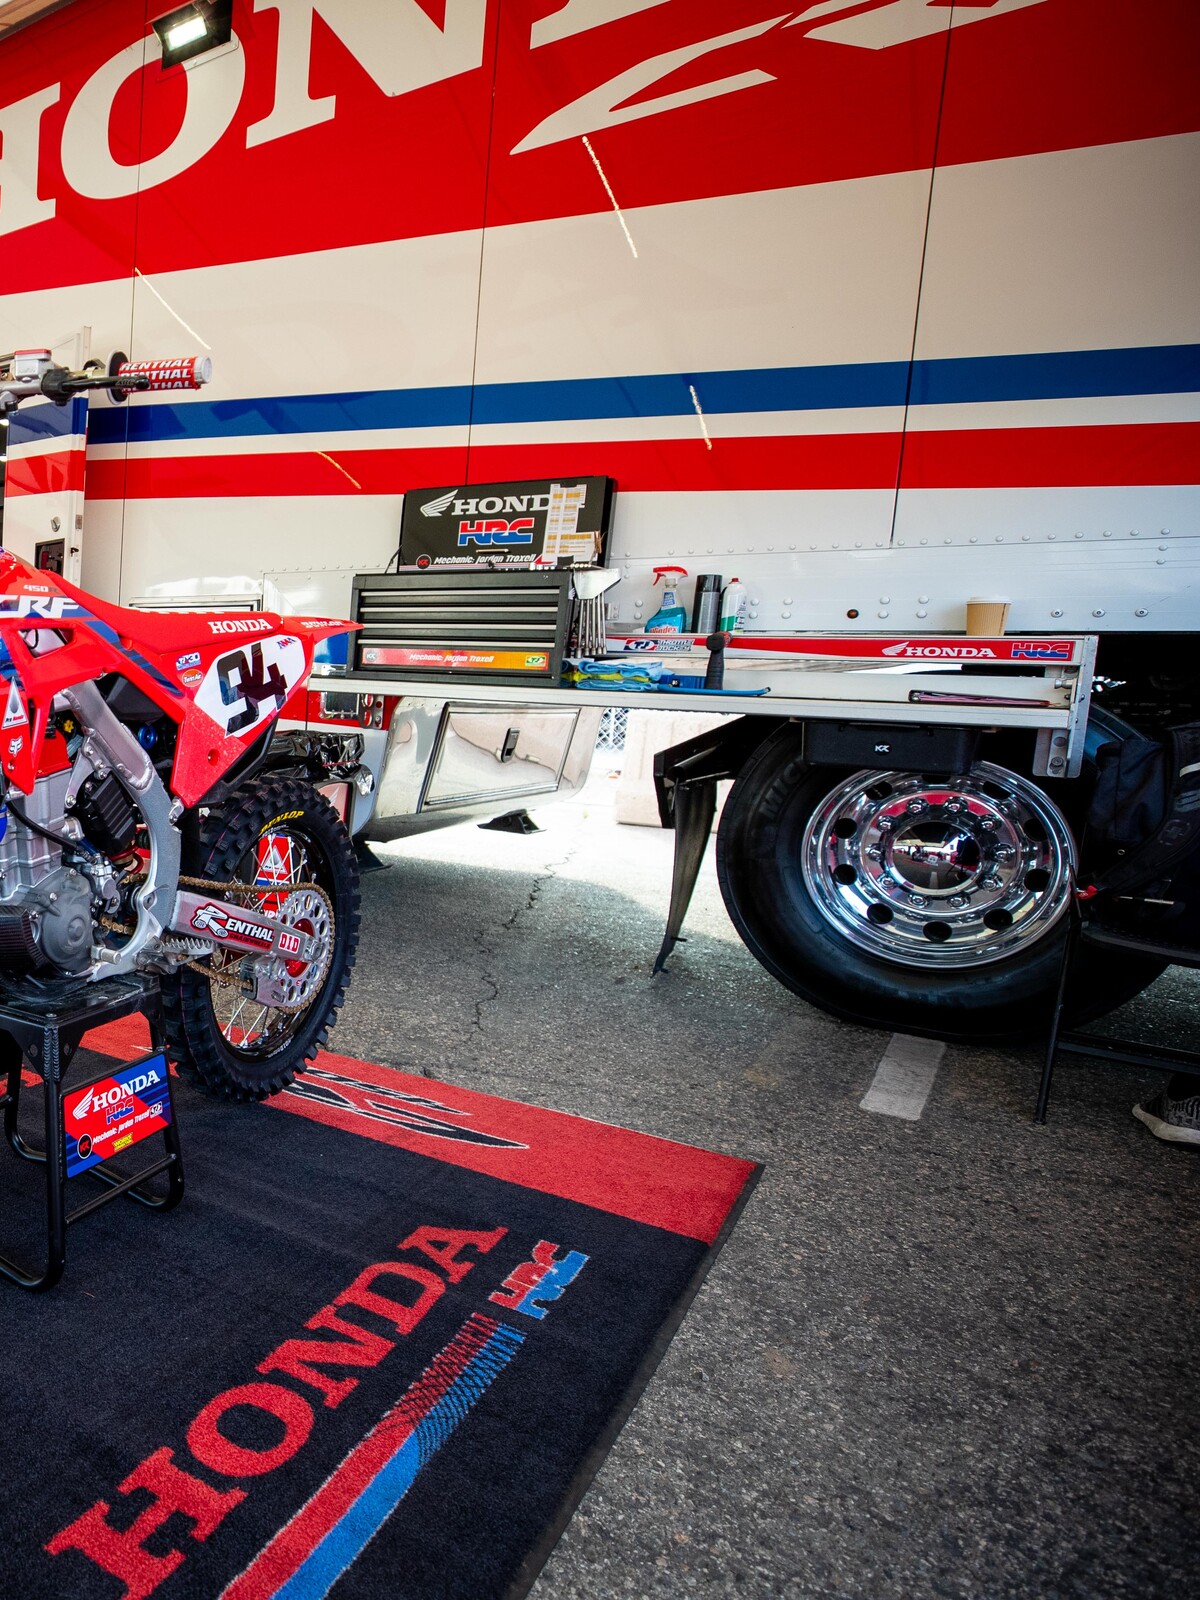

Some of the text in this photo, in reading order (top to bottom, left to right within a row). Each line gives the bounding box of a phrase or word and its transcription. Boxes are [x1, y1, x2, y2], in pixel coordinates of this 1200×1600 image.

[120, 358, 191, 371] RENTHAL
[451, 493, 587, 517] HOND
[457, 517, 535, 547] HRC
[504, 553, 537, 564] Troxell
[207, 618, 274, 635] HONDA
[902, 646, 997, 658] HONDA
[1010, 642, 1071, 659] HRC
[279, 933, 301, 952] DID
[91, 1069, 161, 1113] HONDA
[43, 1224, 510, 1600] HONDA
